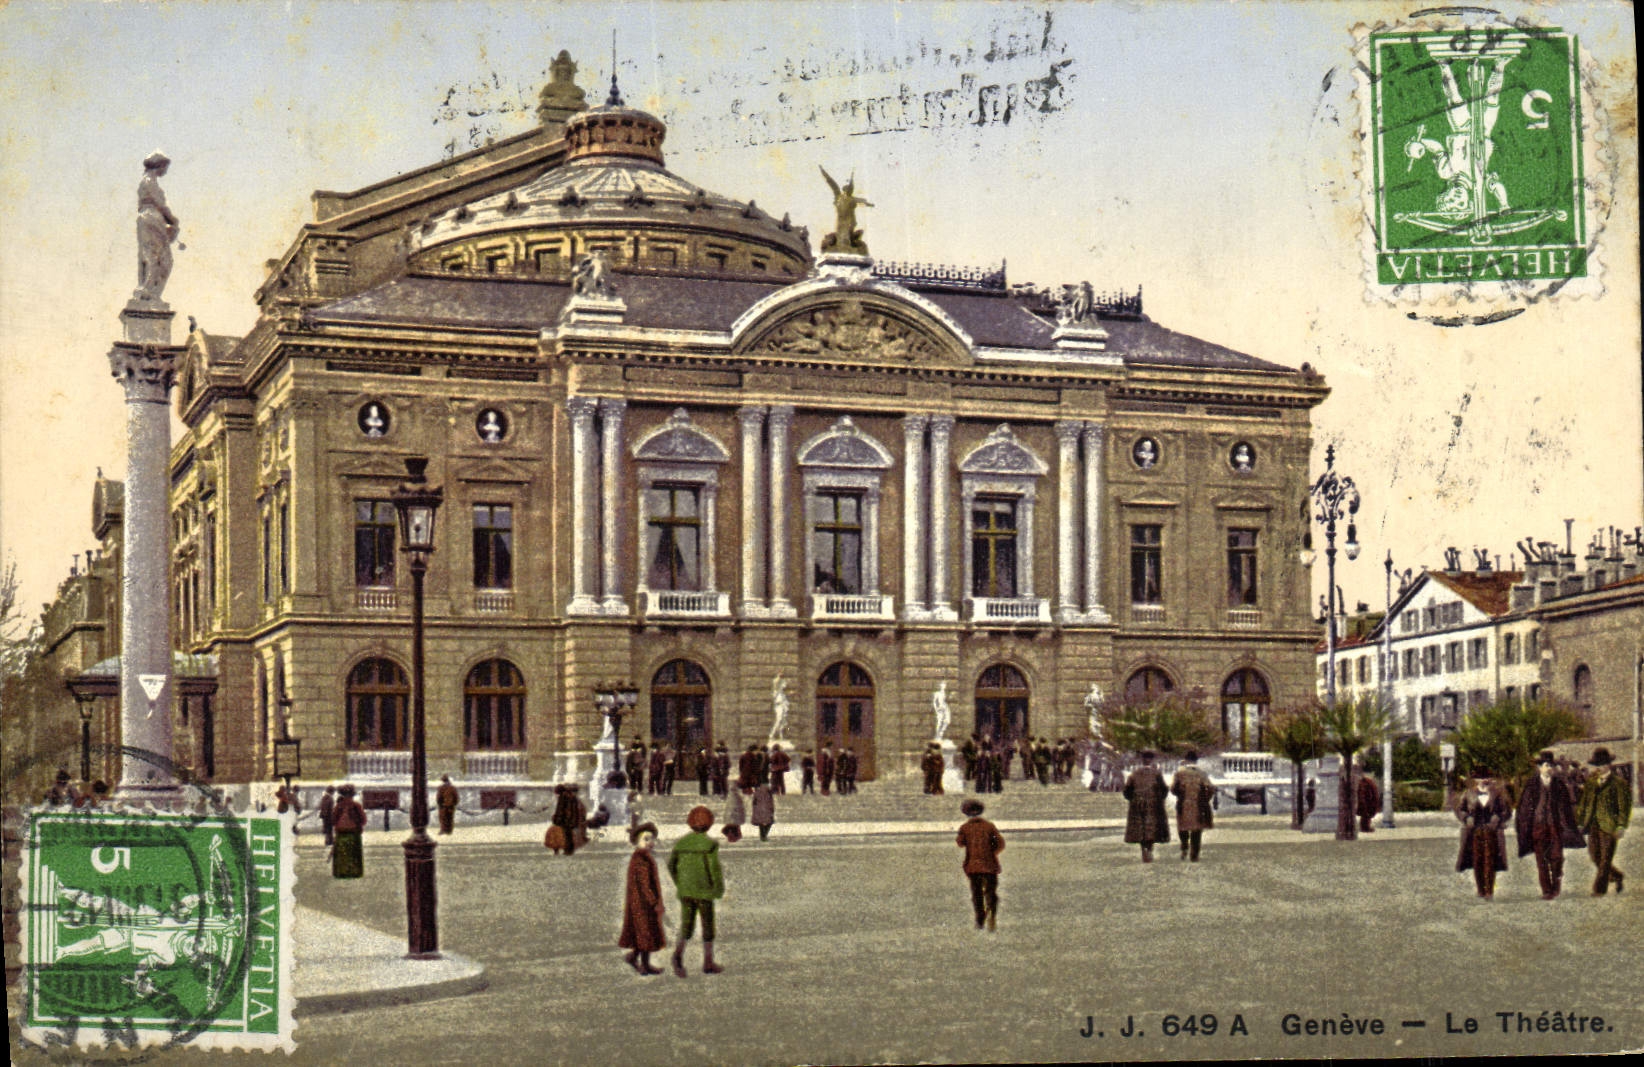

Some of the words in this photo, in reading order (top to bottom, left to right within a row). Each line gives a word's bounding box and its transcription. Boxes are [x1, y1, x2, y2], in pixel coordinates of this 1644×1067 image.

[1521, 88, 1554, 130] 5
[1386, 250, 1572, 280] HELVETIA
[90, 845, 132, 875] 5
[248, 833, 277, 1022] HELVETIA
